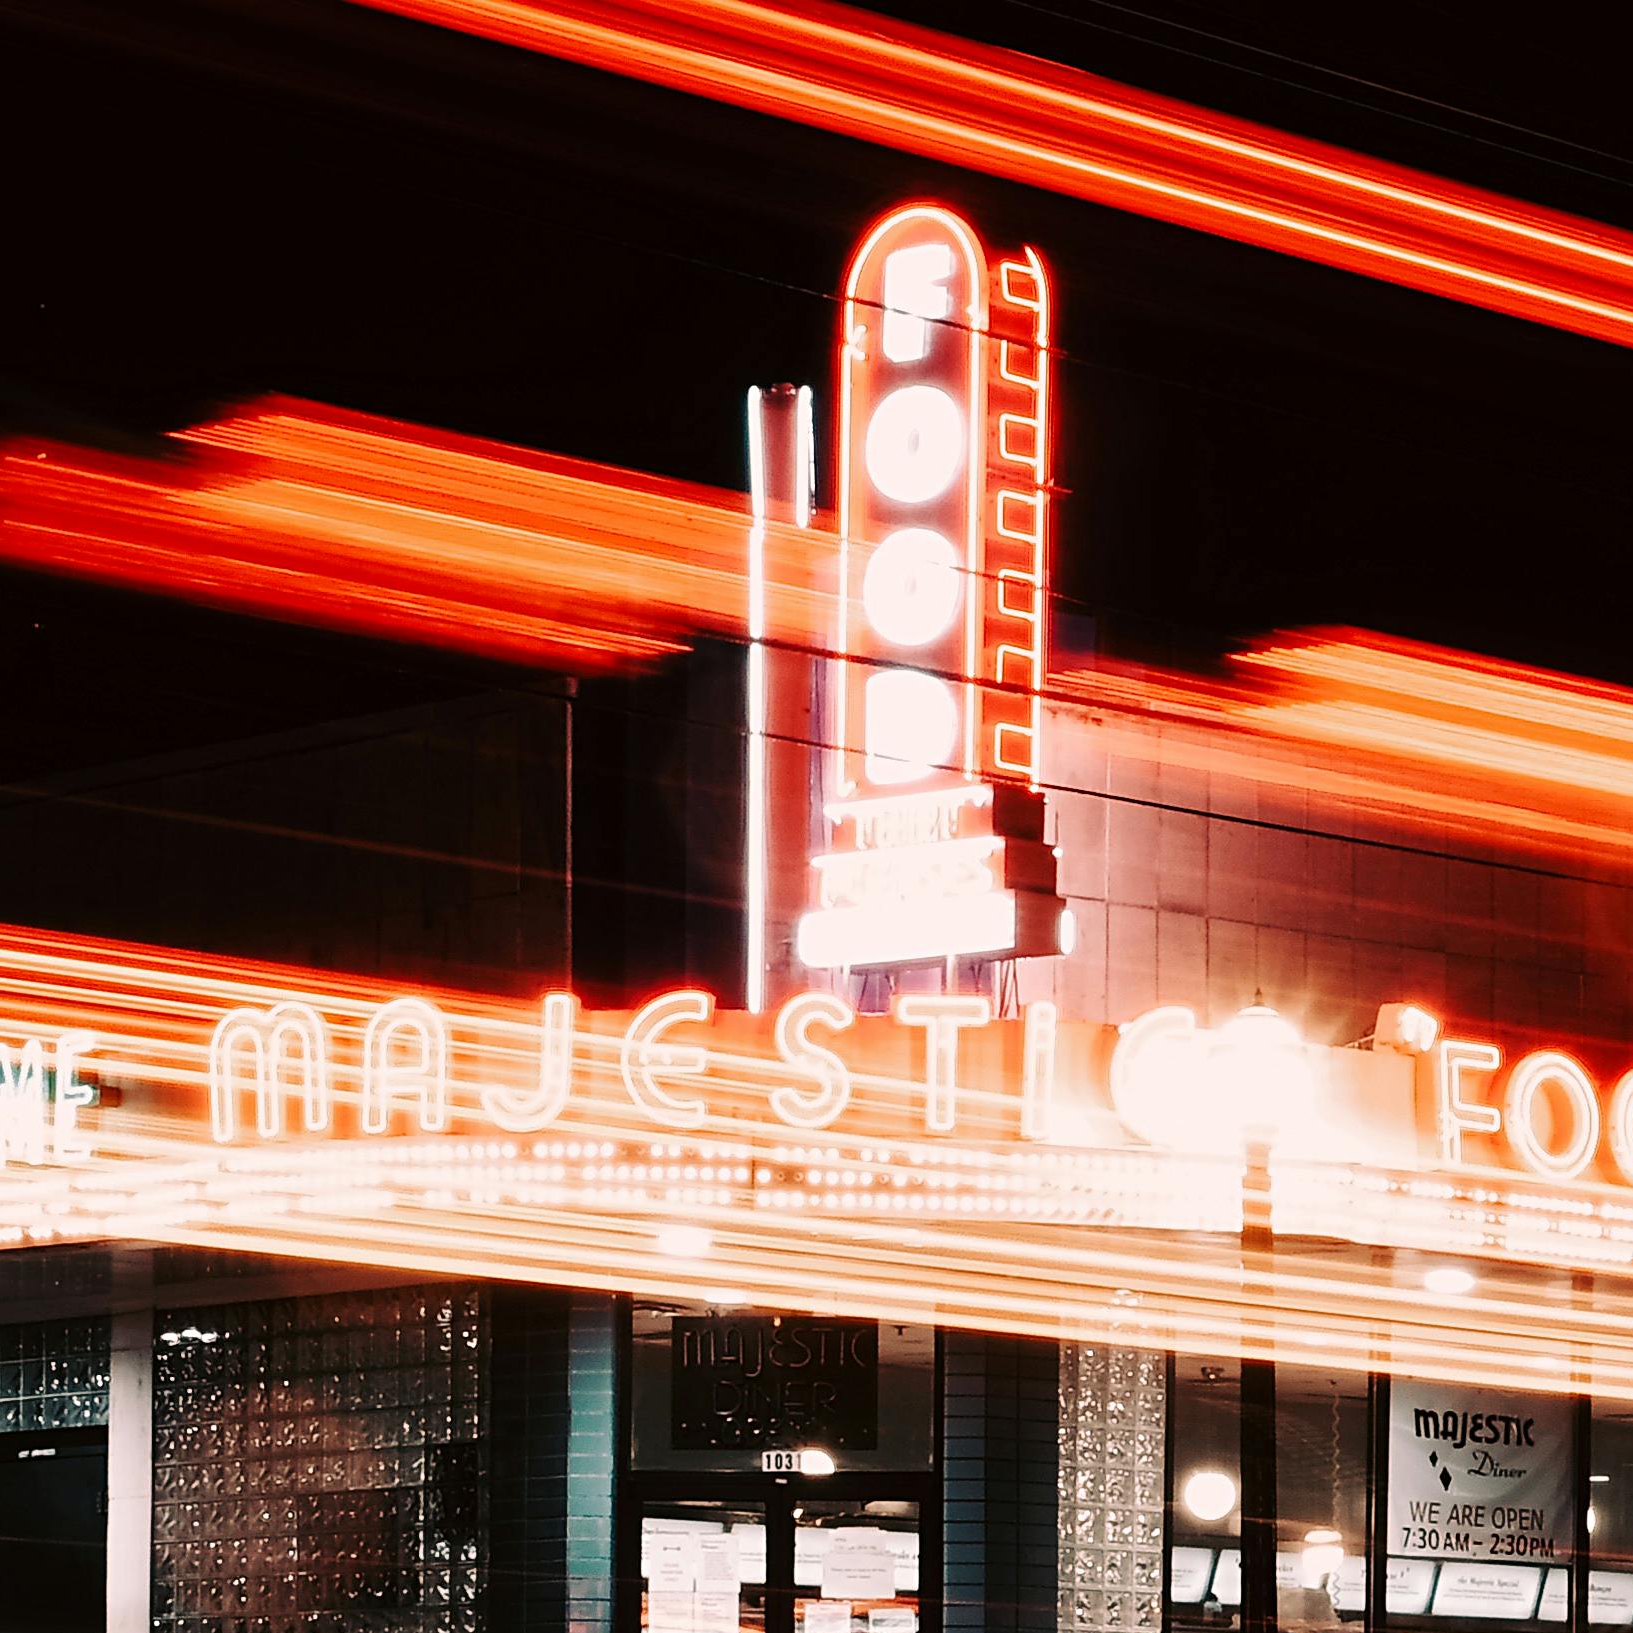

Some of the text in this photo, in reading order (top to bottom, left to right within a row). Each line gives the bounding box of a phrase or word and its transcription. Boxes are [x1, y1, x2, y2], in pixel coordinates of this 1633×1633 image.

[866, 244, 964, 785] FOOD
[210, 990, 1199, 1143] MAJESTIC
[683, 1328, 867, 1377] MAJESTIC
[713, 1381, 837, 1416] DINER
[1414, 1408, 1535, 1449] MAJESTIC
[1468, 1450, 1527, 1478] Diner
[1410, 1501, 1543, 1530] WE ARE OPEN
